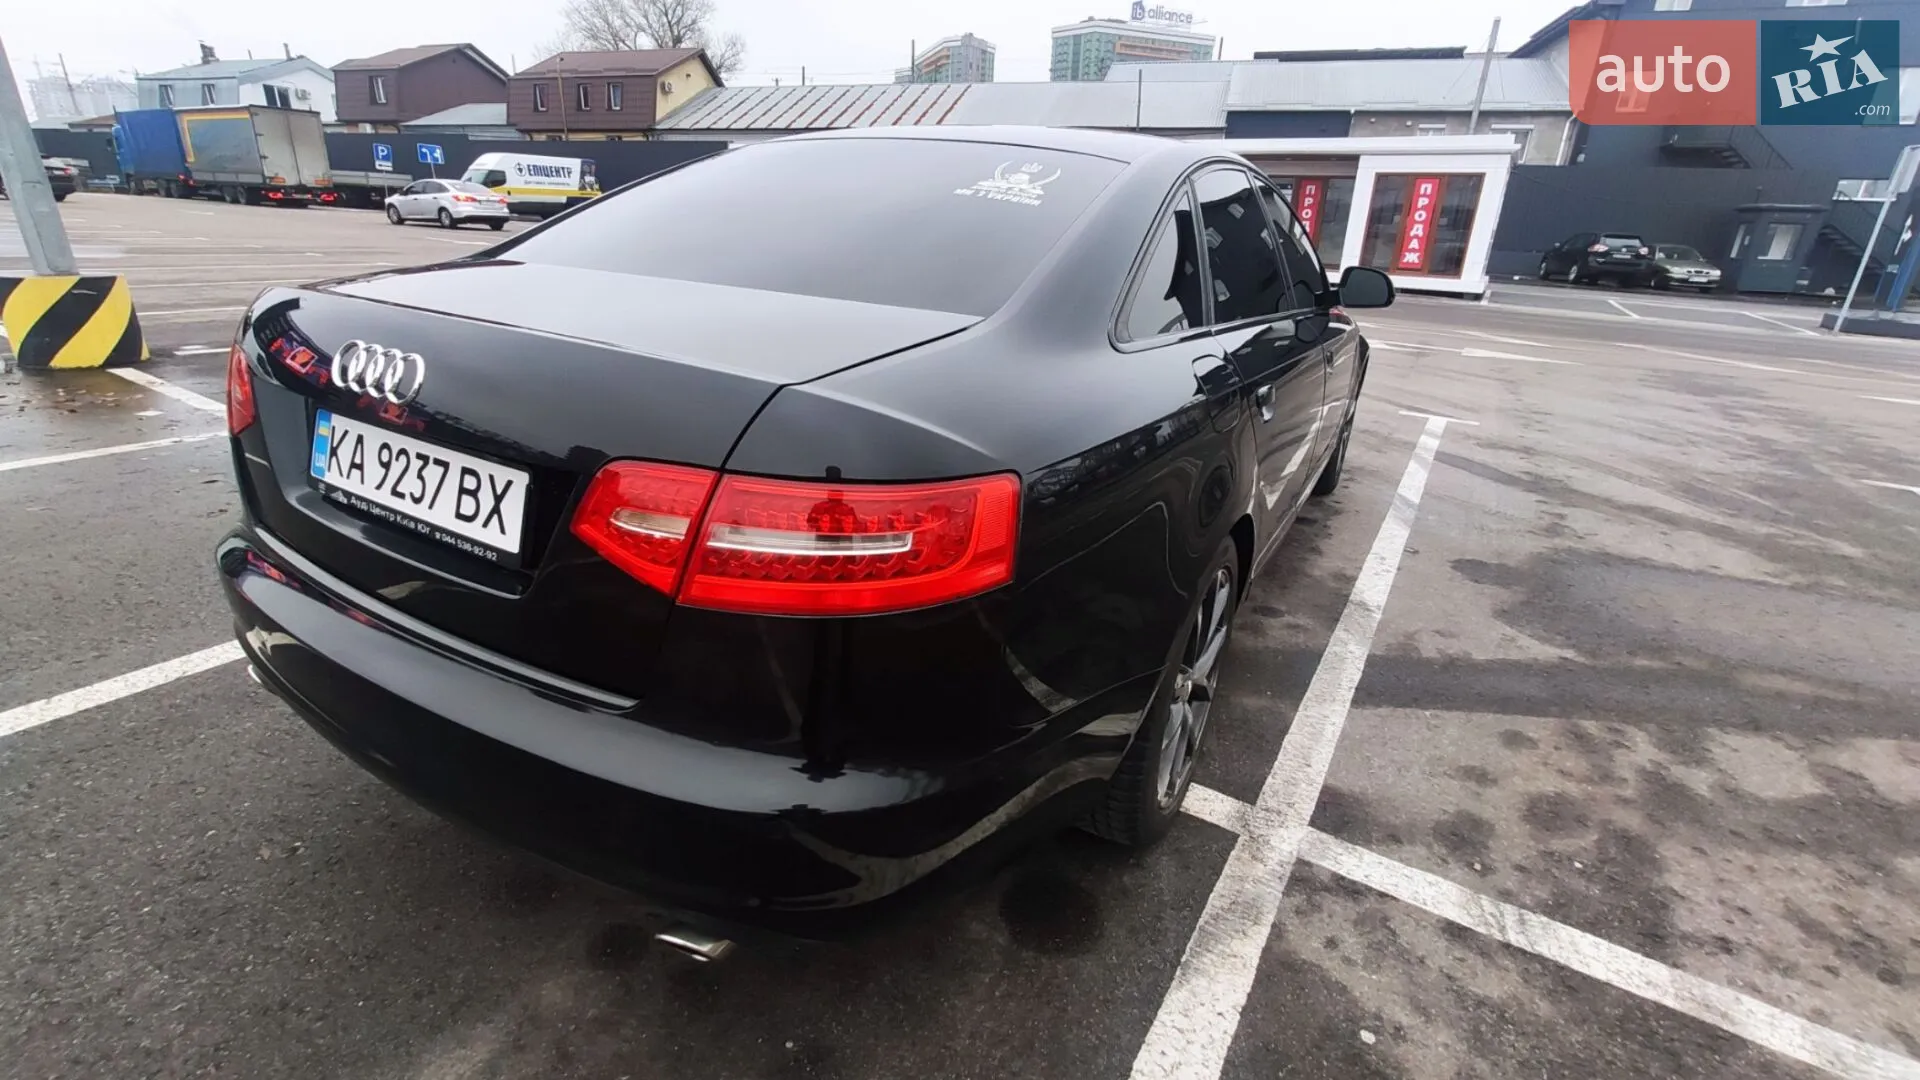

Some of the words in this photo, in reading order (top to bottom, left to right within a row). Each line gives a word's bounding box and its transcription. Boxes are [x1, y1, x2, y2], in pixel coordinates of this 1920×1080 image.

[1148, 4, 1193, 23] alliance
[378, 146, 388, 159] P
[526, 164, 573, 179] ЕПІЦЕНТР
[1402, 183, 1432, 264] ПРОДАЖ
[327, 425, 365, 485] KA
[374, 441, 450, 510] 9237
[454, 466, 514, 535] BX
[369, 502, 396, 521] Центр
[417, 522, 431, 534] Юг
[441, 533, 456, 546] 044
